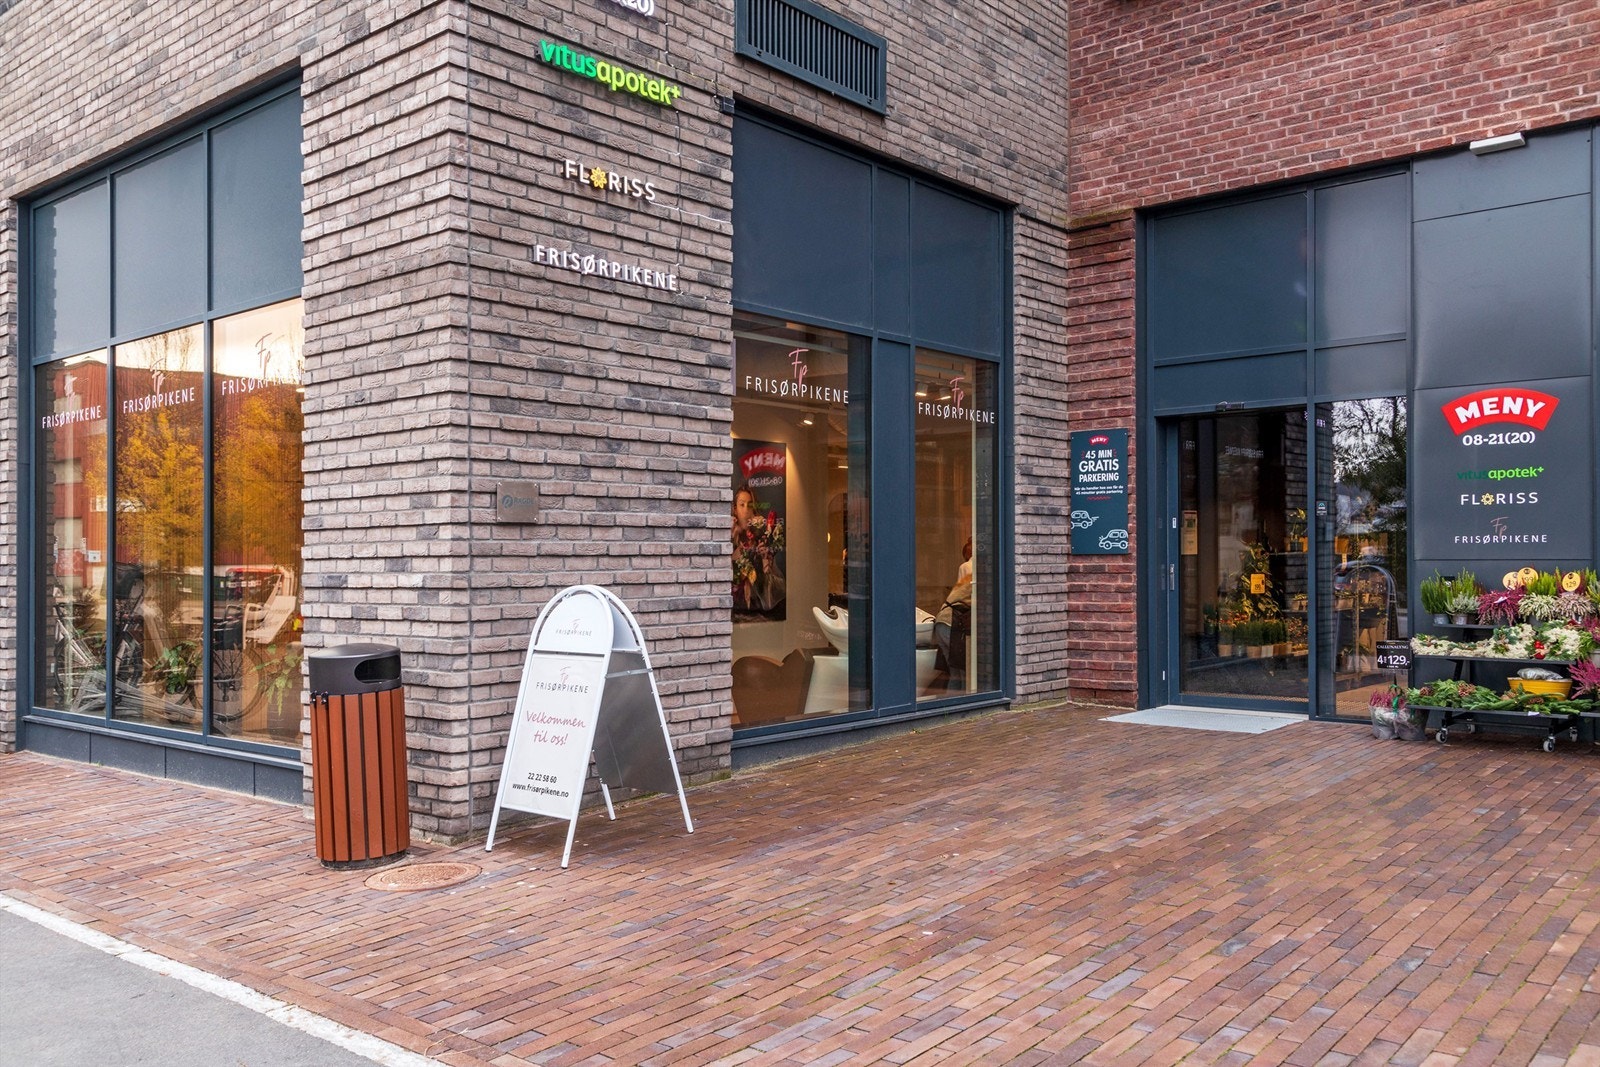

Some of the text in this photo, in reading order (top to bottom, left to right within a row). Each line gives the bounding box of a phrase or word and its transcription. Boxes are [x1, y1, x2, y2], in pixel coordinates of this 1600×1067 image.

[533, 245, 677, 291] FRISØRPIKENE
[745, 375, 850, 404] FRISØRPIKENE
[123, 386, 195, 414] FRISØRPIKENE
[42, 405, 102, 429] FRISØRPIKENE
[918, 401, 996, 425] FRISØRPIKENE
[1454, 396, 1546, 424] MENY
[1462, 431, 1536, 446] 08-21(20)
[1085, 449, 1112, 459] 45 MIN
[1079, 458, 1119, 472] GRATIS
[1079, 472, 1119, 482] PARKERING
[1454, 534, 1548, 544] FRISØRPIKENE
[535, 681, 590, 694] FRISØRPIKENE
[526, 710, 587, 728] Velkommen
[533, 730, 569, 746] til oss!
[527, 772, 535, 780] 22
[535, 773, 543, 782] 22
